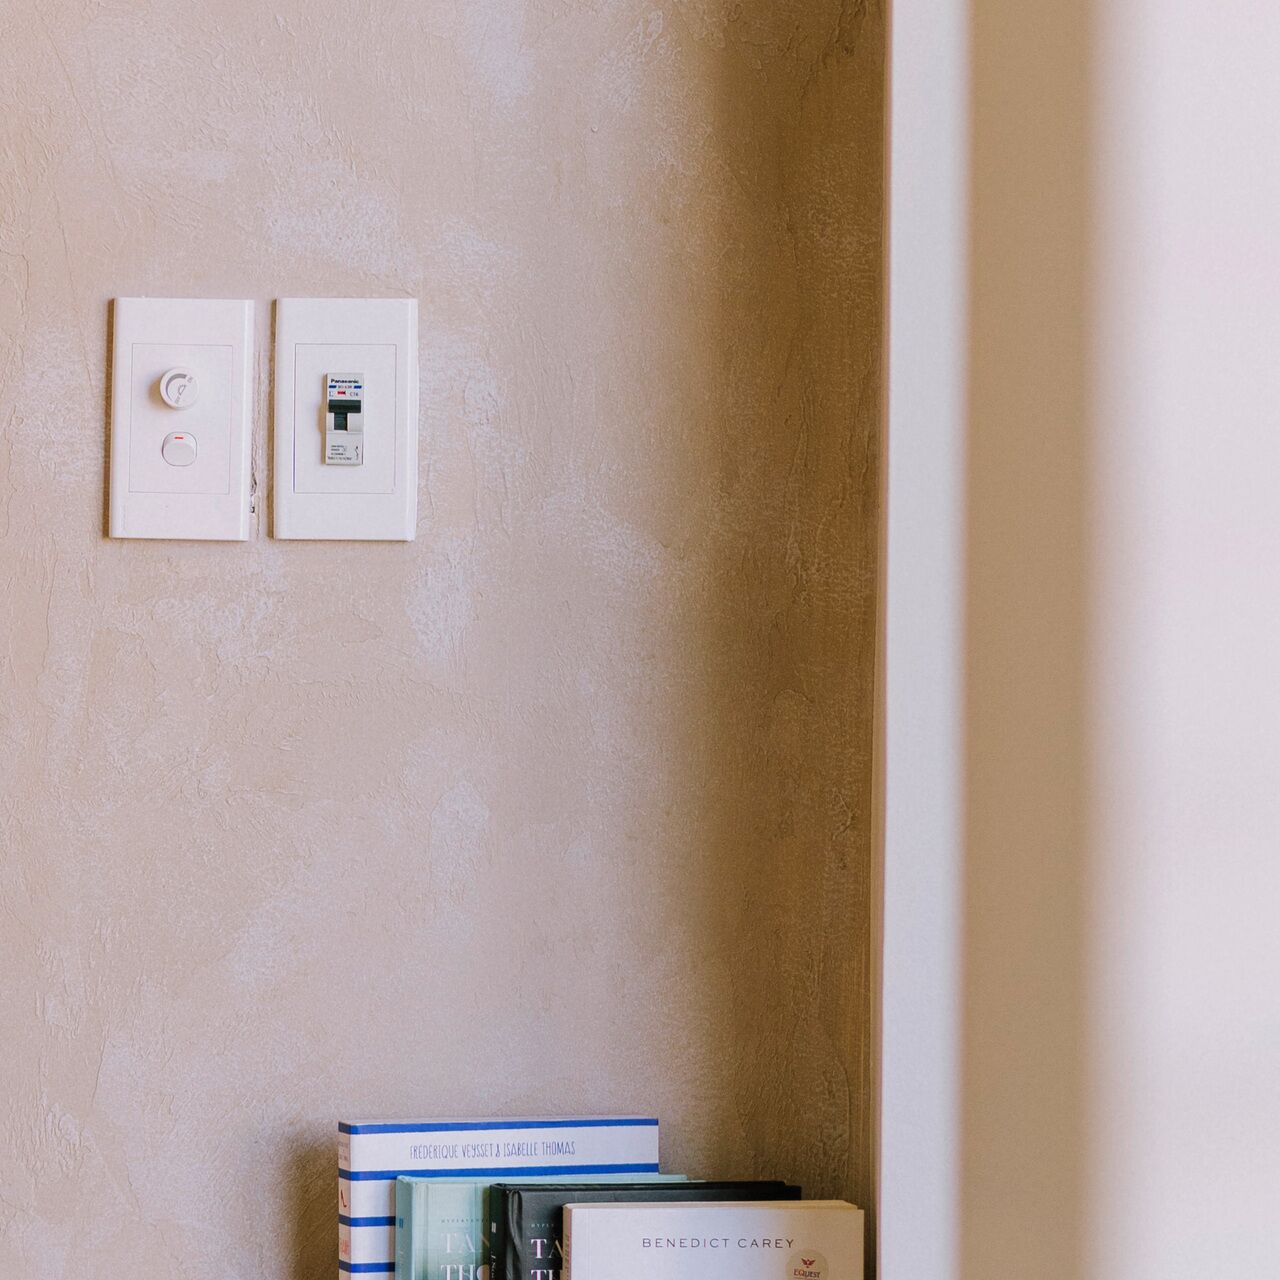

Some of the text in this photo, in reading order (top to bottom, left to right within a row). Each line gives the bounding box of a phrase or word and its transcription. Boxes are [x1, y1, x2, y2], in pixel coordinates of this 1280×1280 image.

[503, 1141, 538, 1158] ISABELLE
[542, 1140, 576, 1156] THOMAS
[642, 1238, 795, 1249] BENEDICT CAREY
